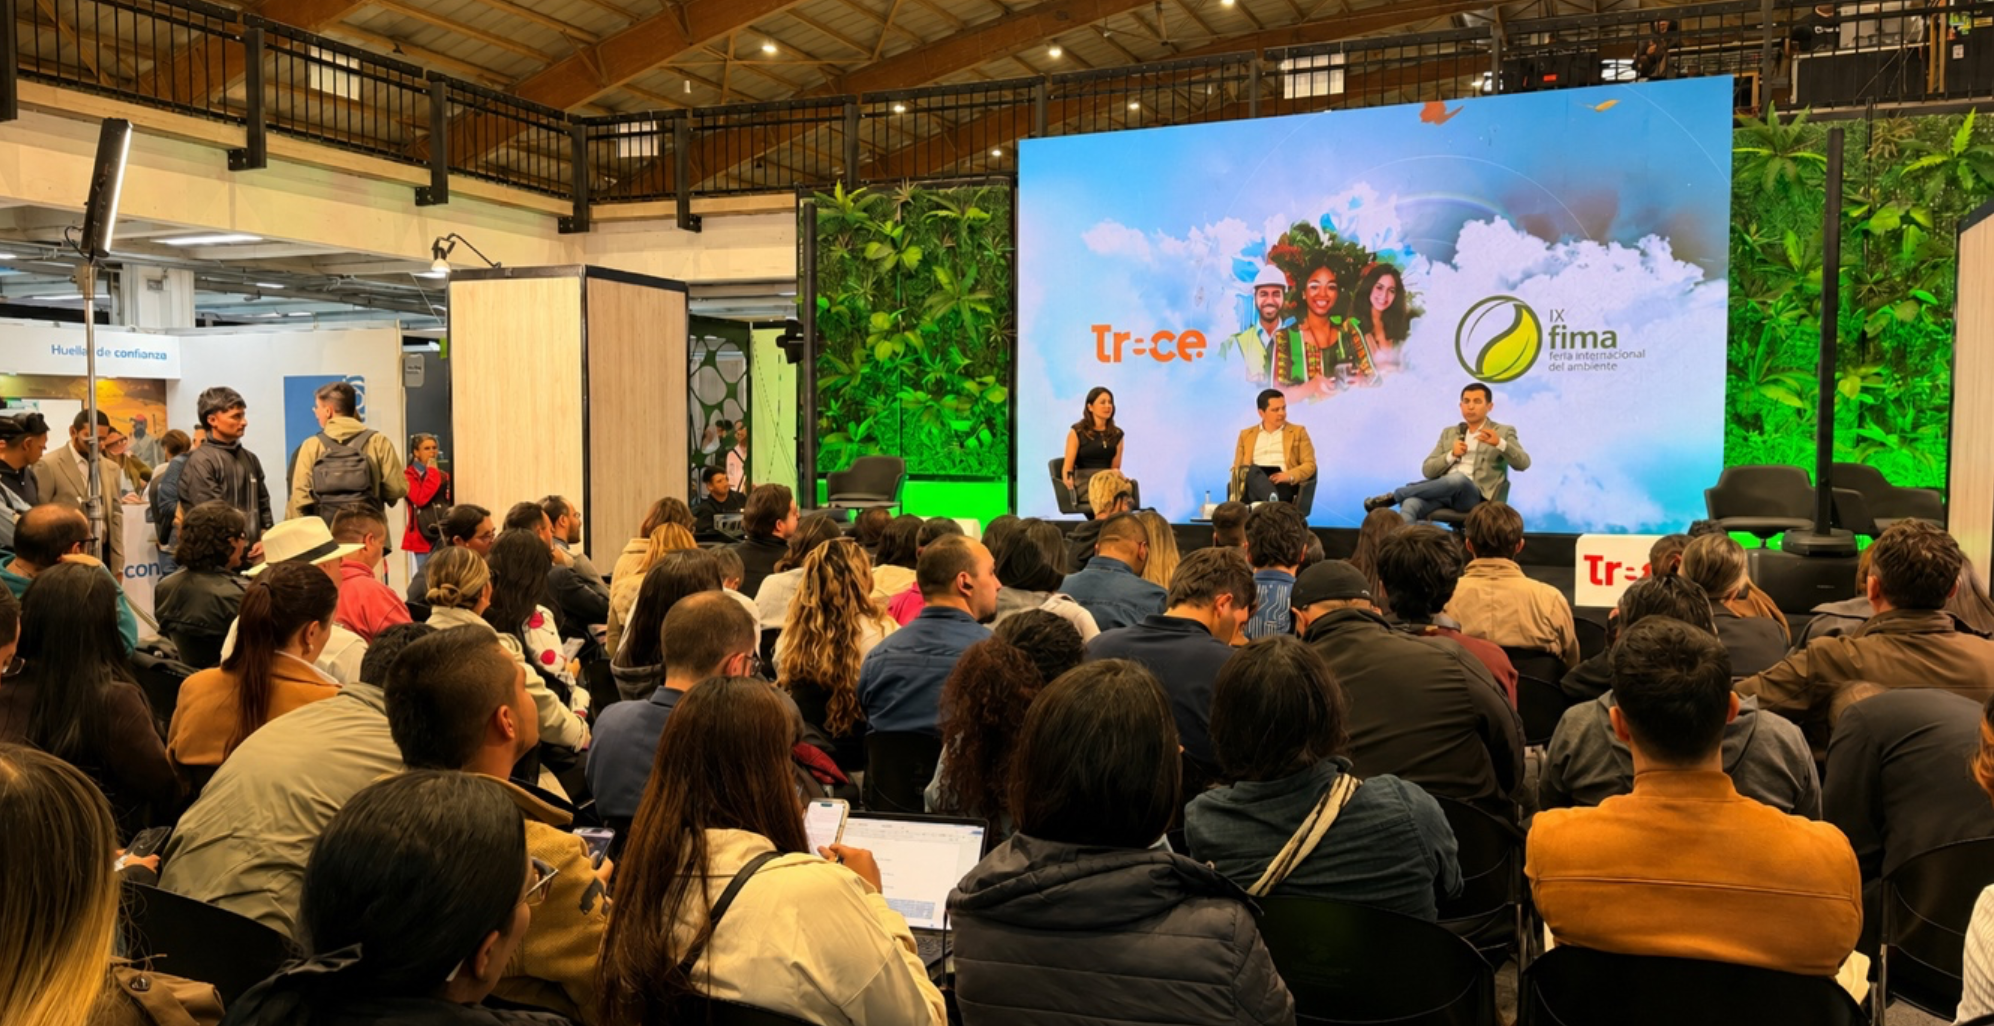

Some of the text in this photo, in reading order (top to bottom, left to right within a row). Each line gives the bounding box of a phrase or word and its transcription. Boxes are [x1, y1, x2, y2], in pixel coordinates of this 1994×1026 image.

[1549, 309, 1565, 322] IX
[1548, 324, 1617, 349] fima
[51, 344, 167, 360] Huella de confianza
[1549, 350, 1645, 361] feria internacional
[1548, 362, 1618, 371] del ambiente
